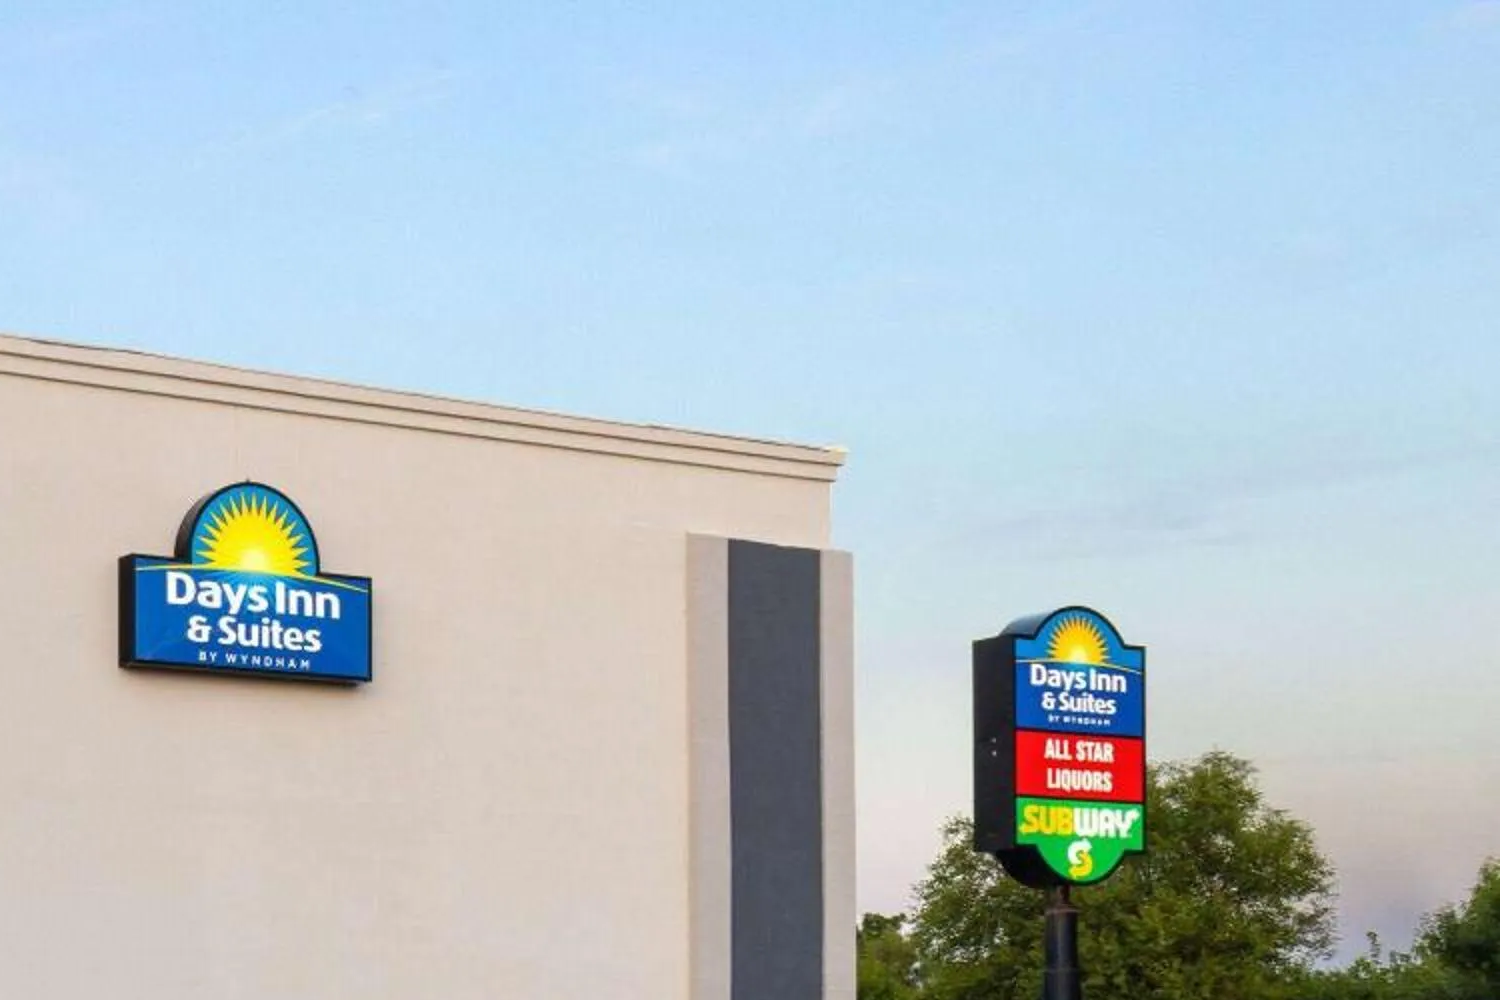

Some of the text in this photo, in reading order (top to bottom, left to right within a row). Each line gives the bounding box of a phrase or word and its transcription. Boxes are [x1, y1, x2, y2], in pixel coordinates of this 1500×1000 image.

[165, 571, 341, 619] Days Inn
[187, 615, 322, 652] & Suites
[198, 651, 311, 670] BY WYNDHAM
[1029, 663, 1128, 693] Days Inn
[1041, 692, 1117, 715] & Suites
[1044, 738, 1115, 763] ALL STAR
[1046, 768, 1114, 792] LIQUORS
[1018, 804, 1141, 838] SUBWAY
